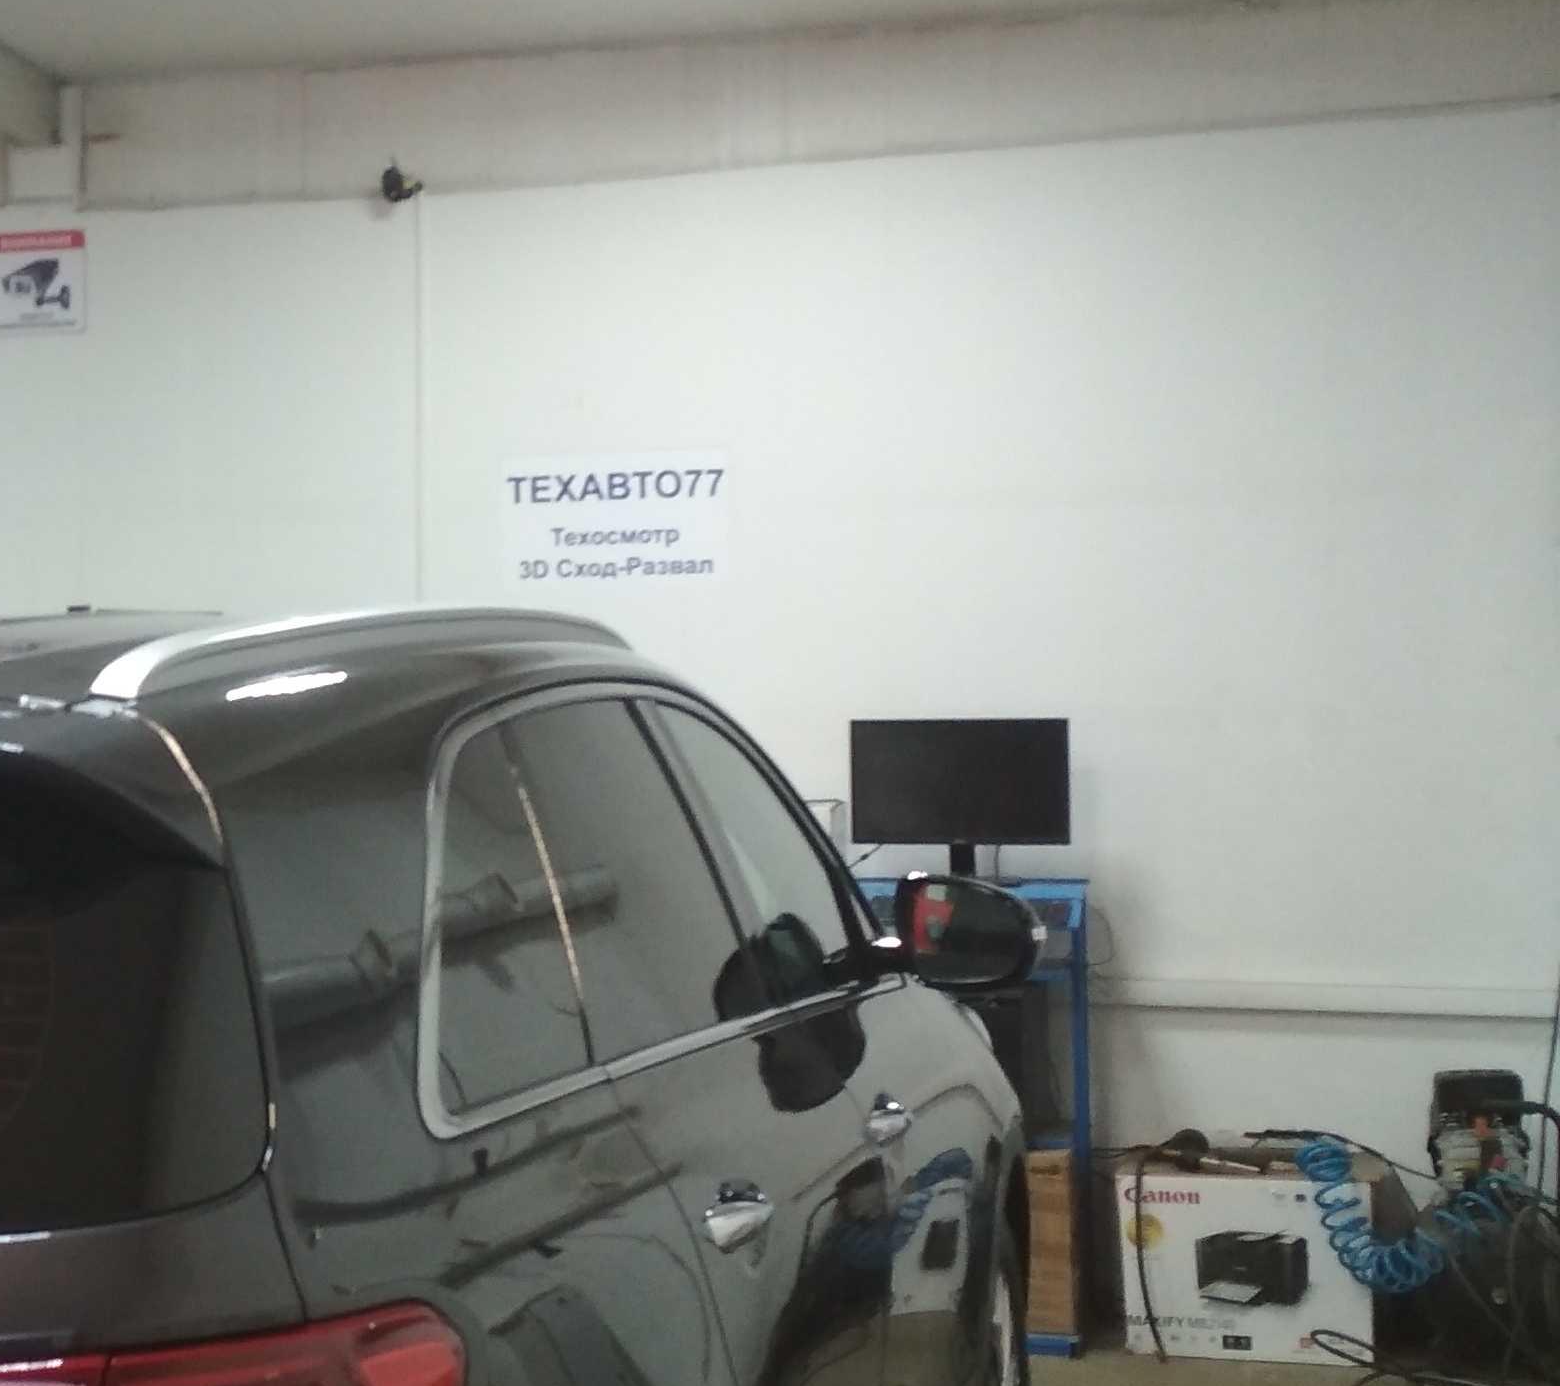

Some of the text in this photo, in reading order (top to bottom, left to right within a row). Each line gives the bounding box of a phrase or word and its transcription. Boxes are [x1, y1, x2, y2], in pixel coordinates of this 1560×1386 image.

[507, 469, 724, 504] ТЕХАВТО77
[552, 527, 680, 547] Техосмотр
[520, 558, 714, 579] 3D Сход-Развал
[1125, 1188, 1201, 1205] Canon
